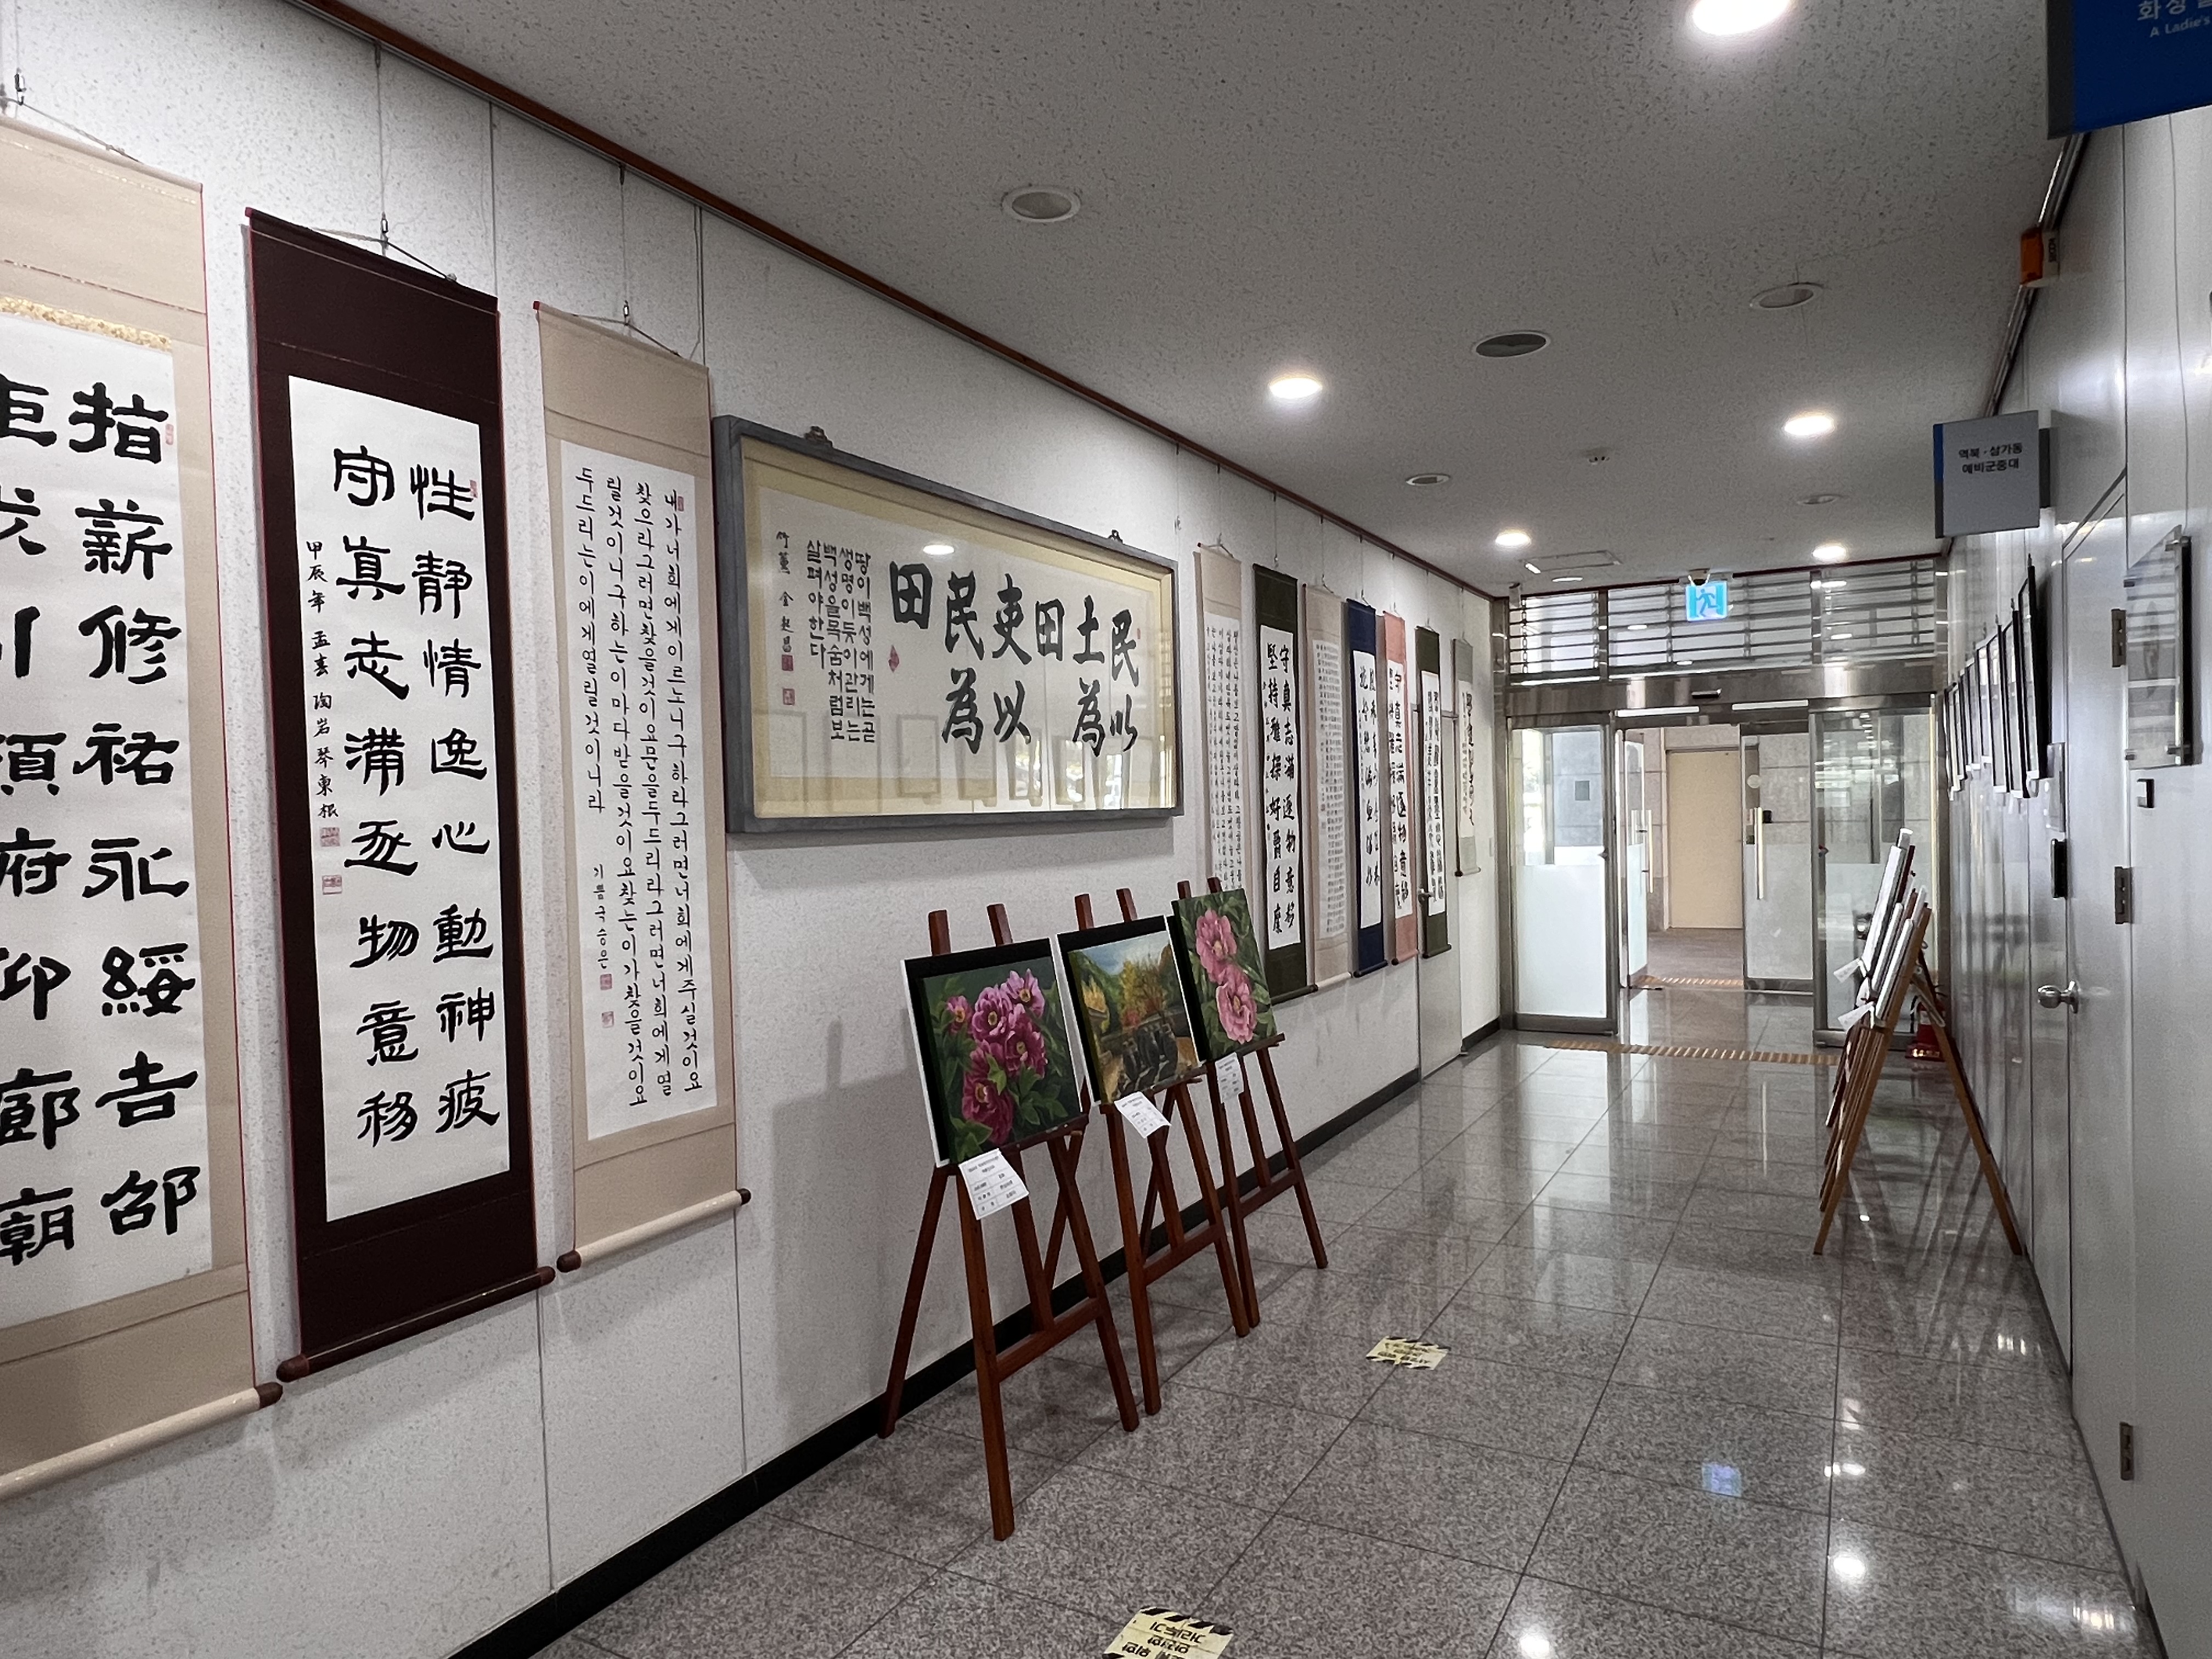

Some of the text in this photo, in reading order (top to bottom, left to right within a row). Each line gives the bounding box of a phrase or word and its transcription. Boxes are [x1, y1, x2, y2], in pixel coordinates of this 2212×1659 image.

[2150, 15, 2211, 37] A Ladie's
[889, 561, 933, 629] 田
[1036, 598, 1066, 662] 田
[1149, 1621, 1206, 1644] 거리두기
